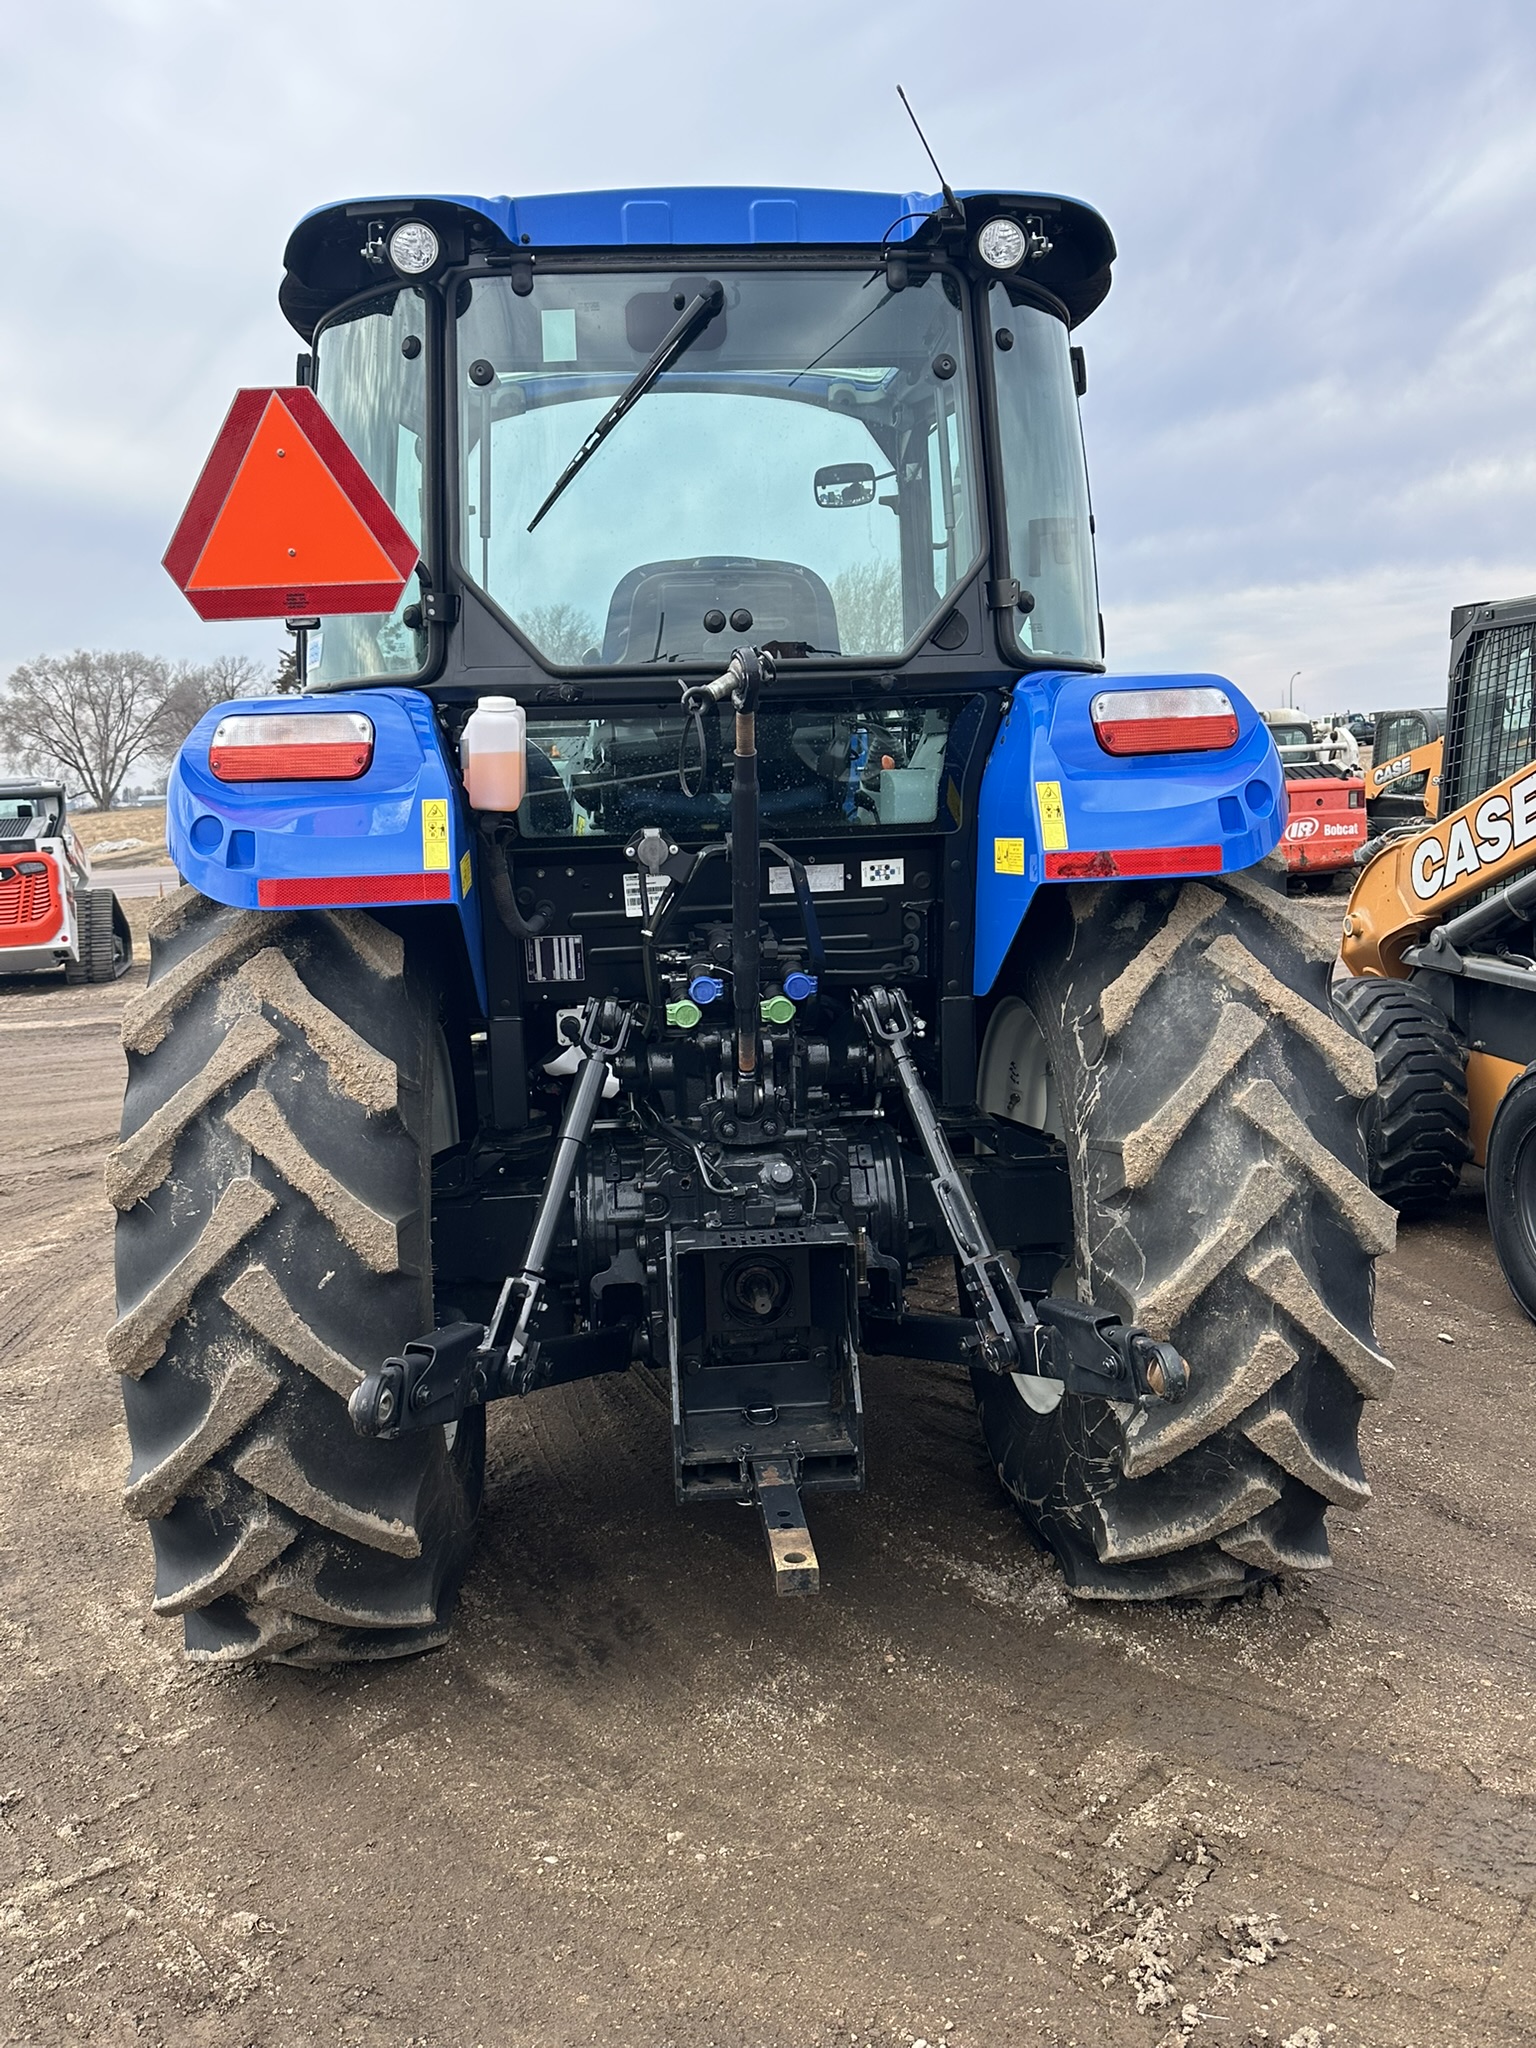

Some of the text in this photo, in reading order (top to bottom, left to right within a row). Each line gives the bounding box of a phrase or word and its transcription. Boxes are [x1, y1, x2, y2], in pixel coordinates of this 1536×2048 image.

[1373, 755, 1412, 786] CASE
[1323, 823, 1359, 837] Bobcat
[1411, 770, 1536, 900] CASE
